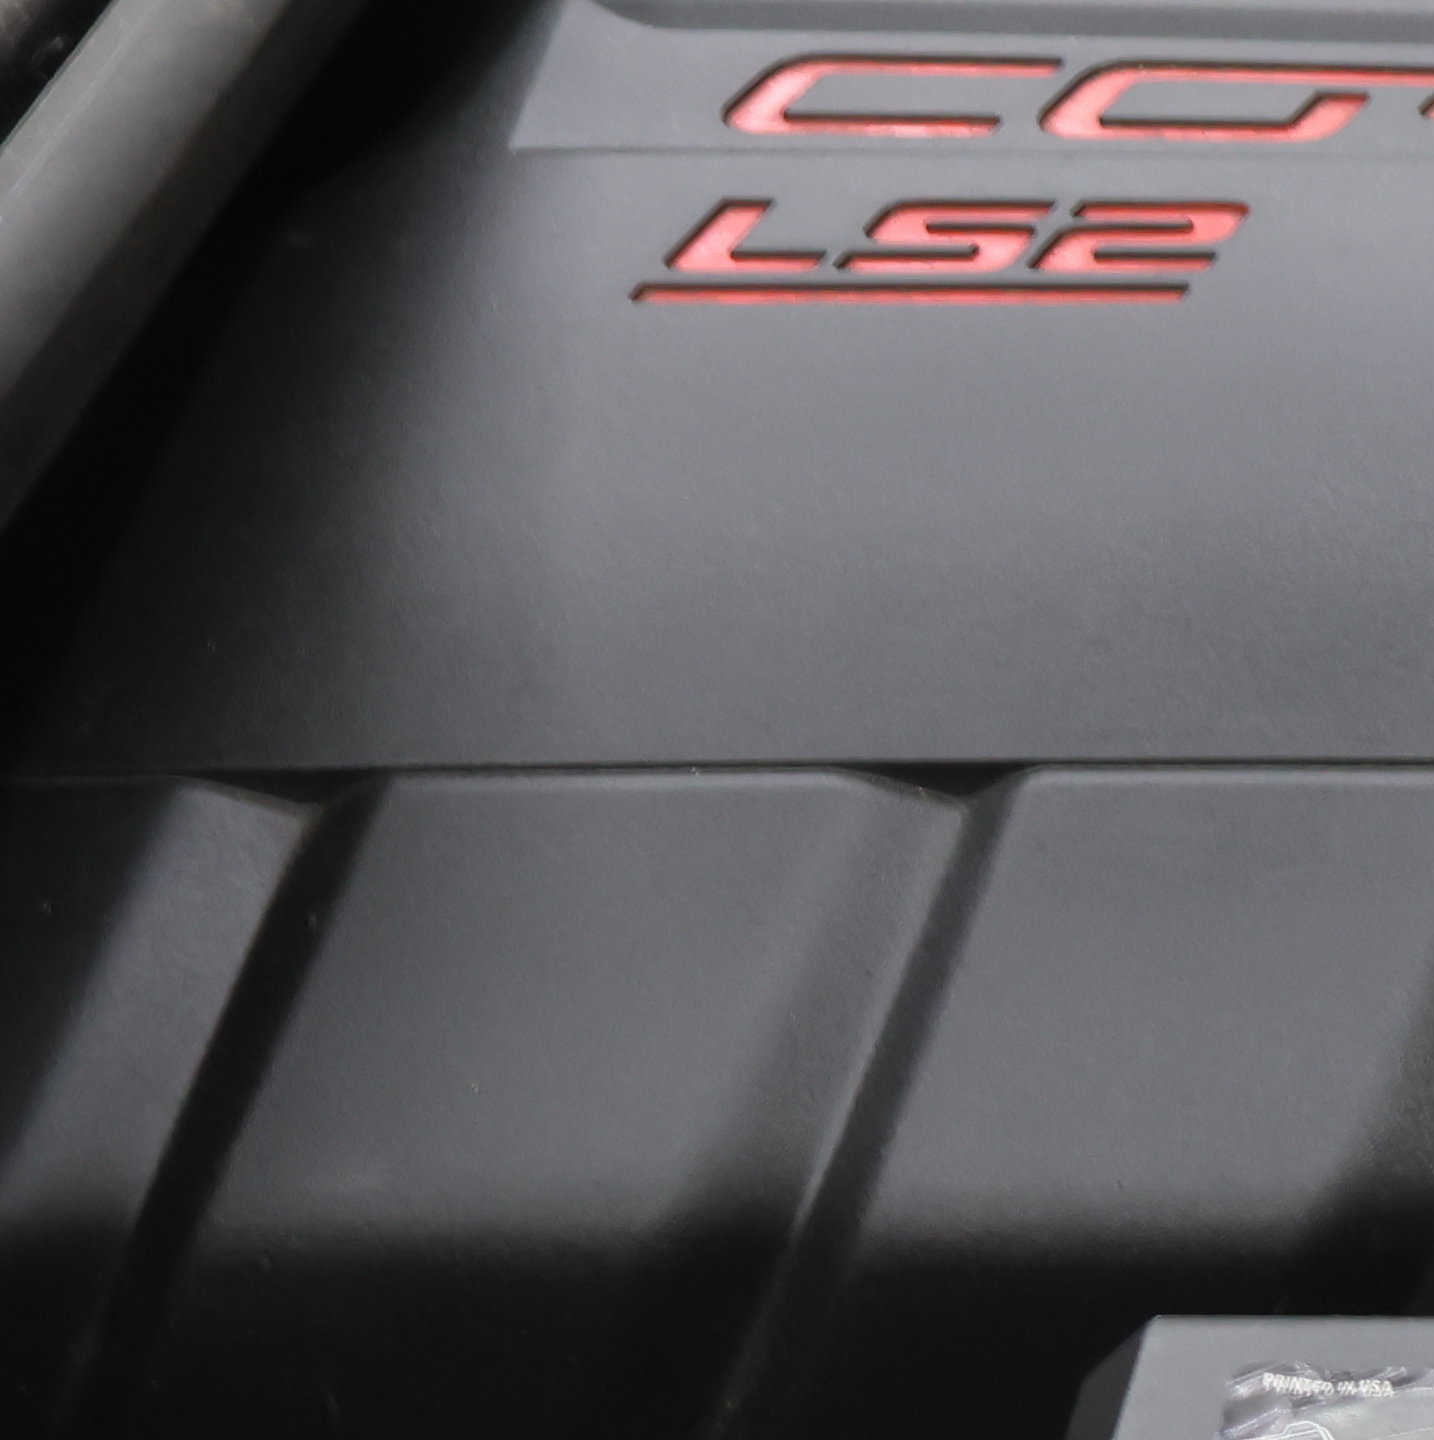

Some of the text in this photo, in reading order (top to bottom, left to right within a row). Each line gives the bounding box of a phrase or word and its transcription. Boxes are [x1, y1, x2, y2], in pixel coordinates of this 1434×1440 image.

[662, 199, 1250, 274] LS2
[1262, 1372, 1334, 1397] PRINTED
[1358, 1379, 1396, 1398] USA
